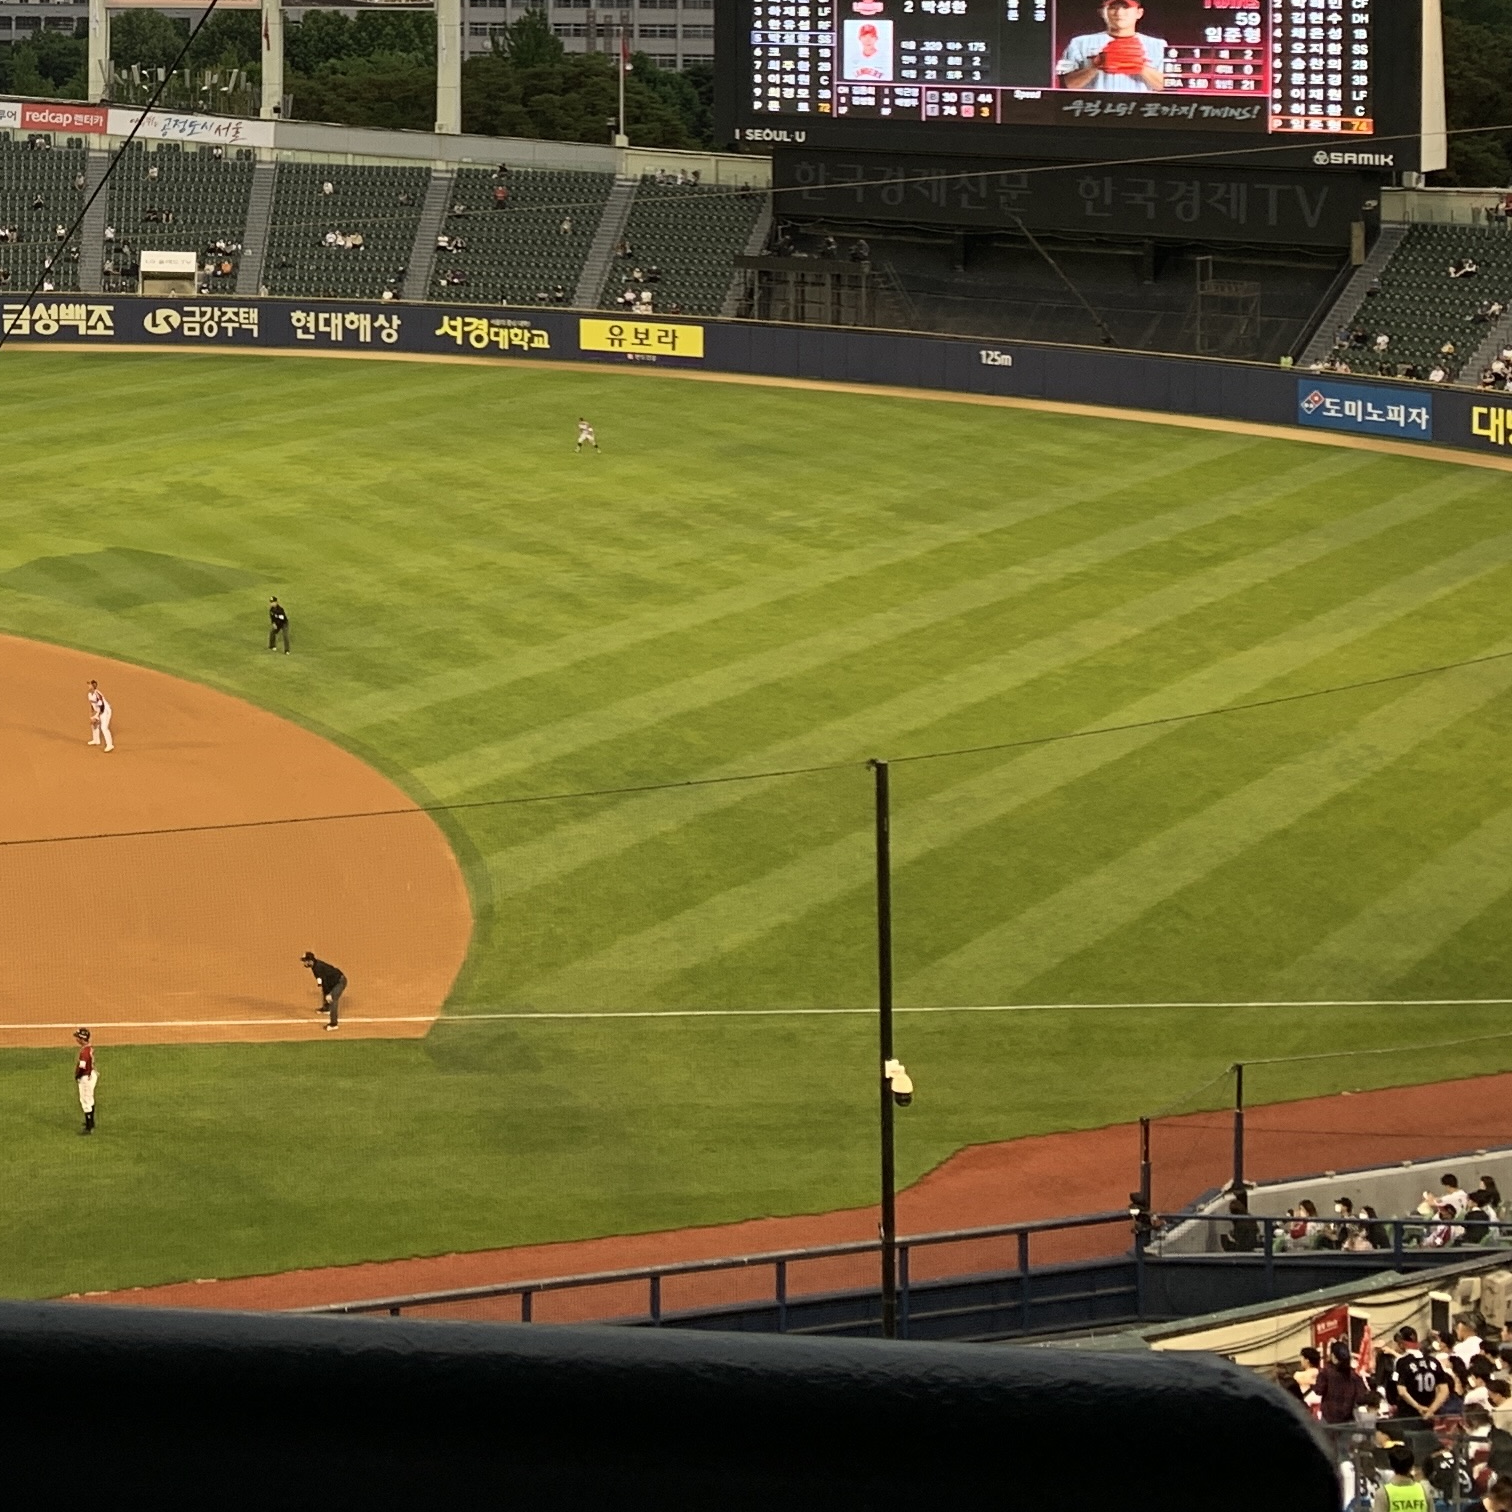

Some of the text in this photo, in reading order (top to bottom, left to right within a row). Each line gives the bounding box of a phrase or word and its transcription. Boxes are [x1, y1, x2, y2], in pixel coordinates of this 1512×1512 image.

[904, 0, 914, 13] 2
[1235, 12, 1261, 26] 59
[25, 108, 104, 128] redcap 렌터카
[214, 121, 247, 143] 서울
[1330, 152, 1394, 166] SAMIK
[1076, 174, 1331, 230] 한국경제TV
[2, 302, 115, 336] 금성백조
[182, 306, 259, 338] 금강주택
[290, 309, 402, 344] 현대해상
[435, 315, 551, 351] 서경대학교
[605, 324, 679, 351] 유보라
[979, 350, 1012, 366] 125m
[1322, 397, 1430, 431] 도미노피자
[1415, 1372, 1436, 1393] 10
[1392, 1500, 1427, 1512] STAFF
